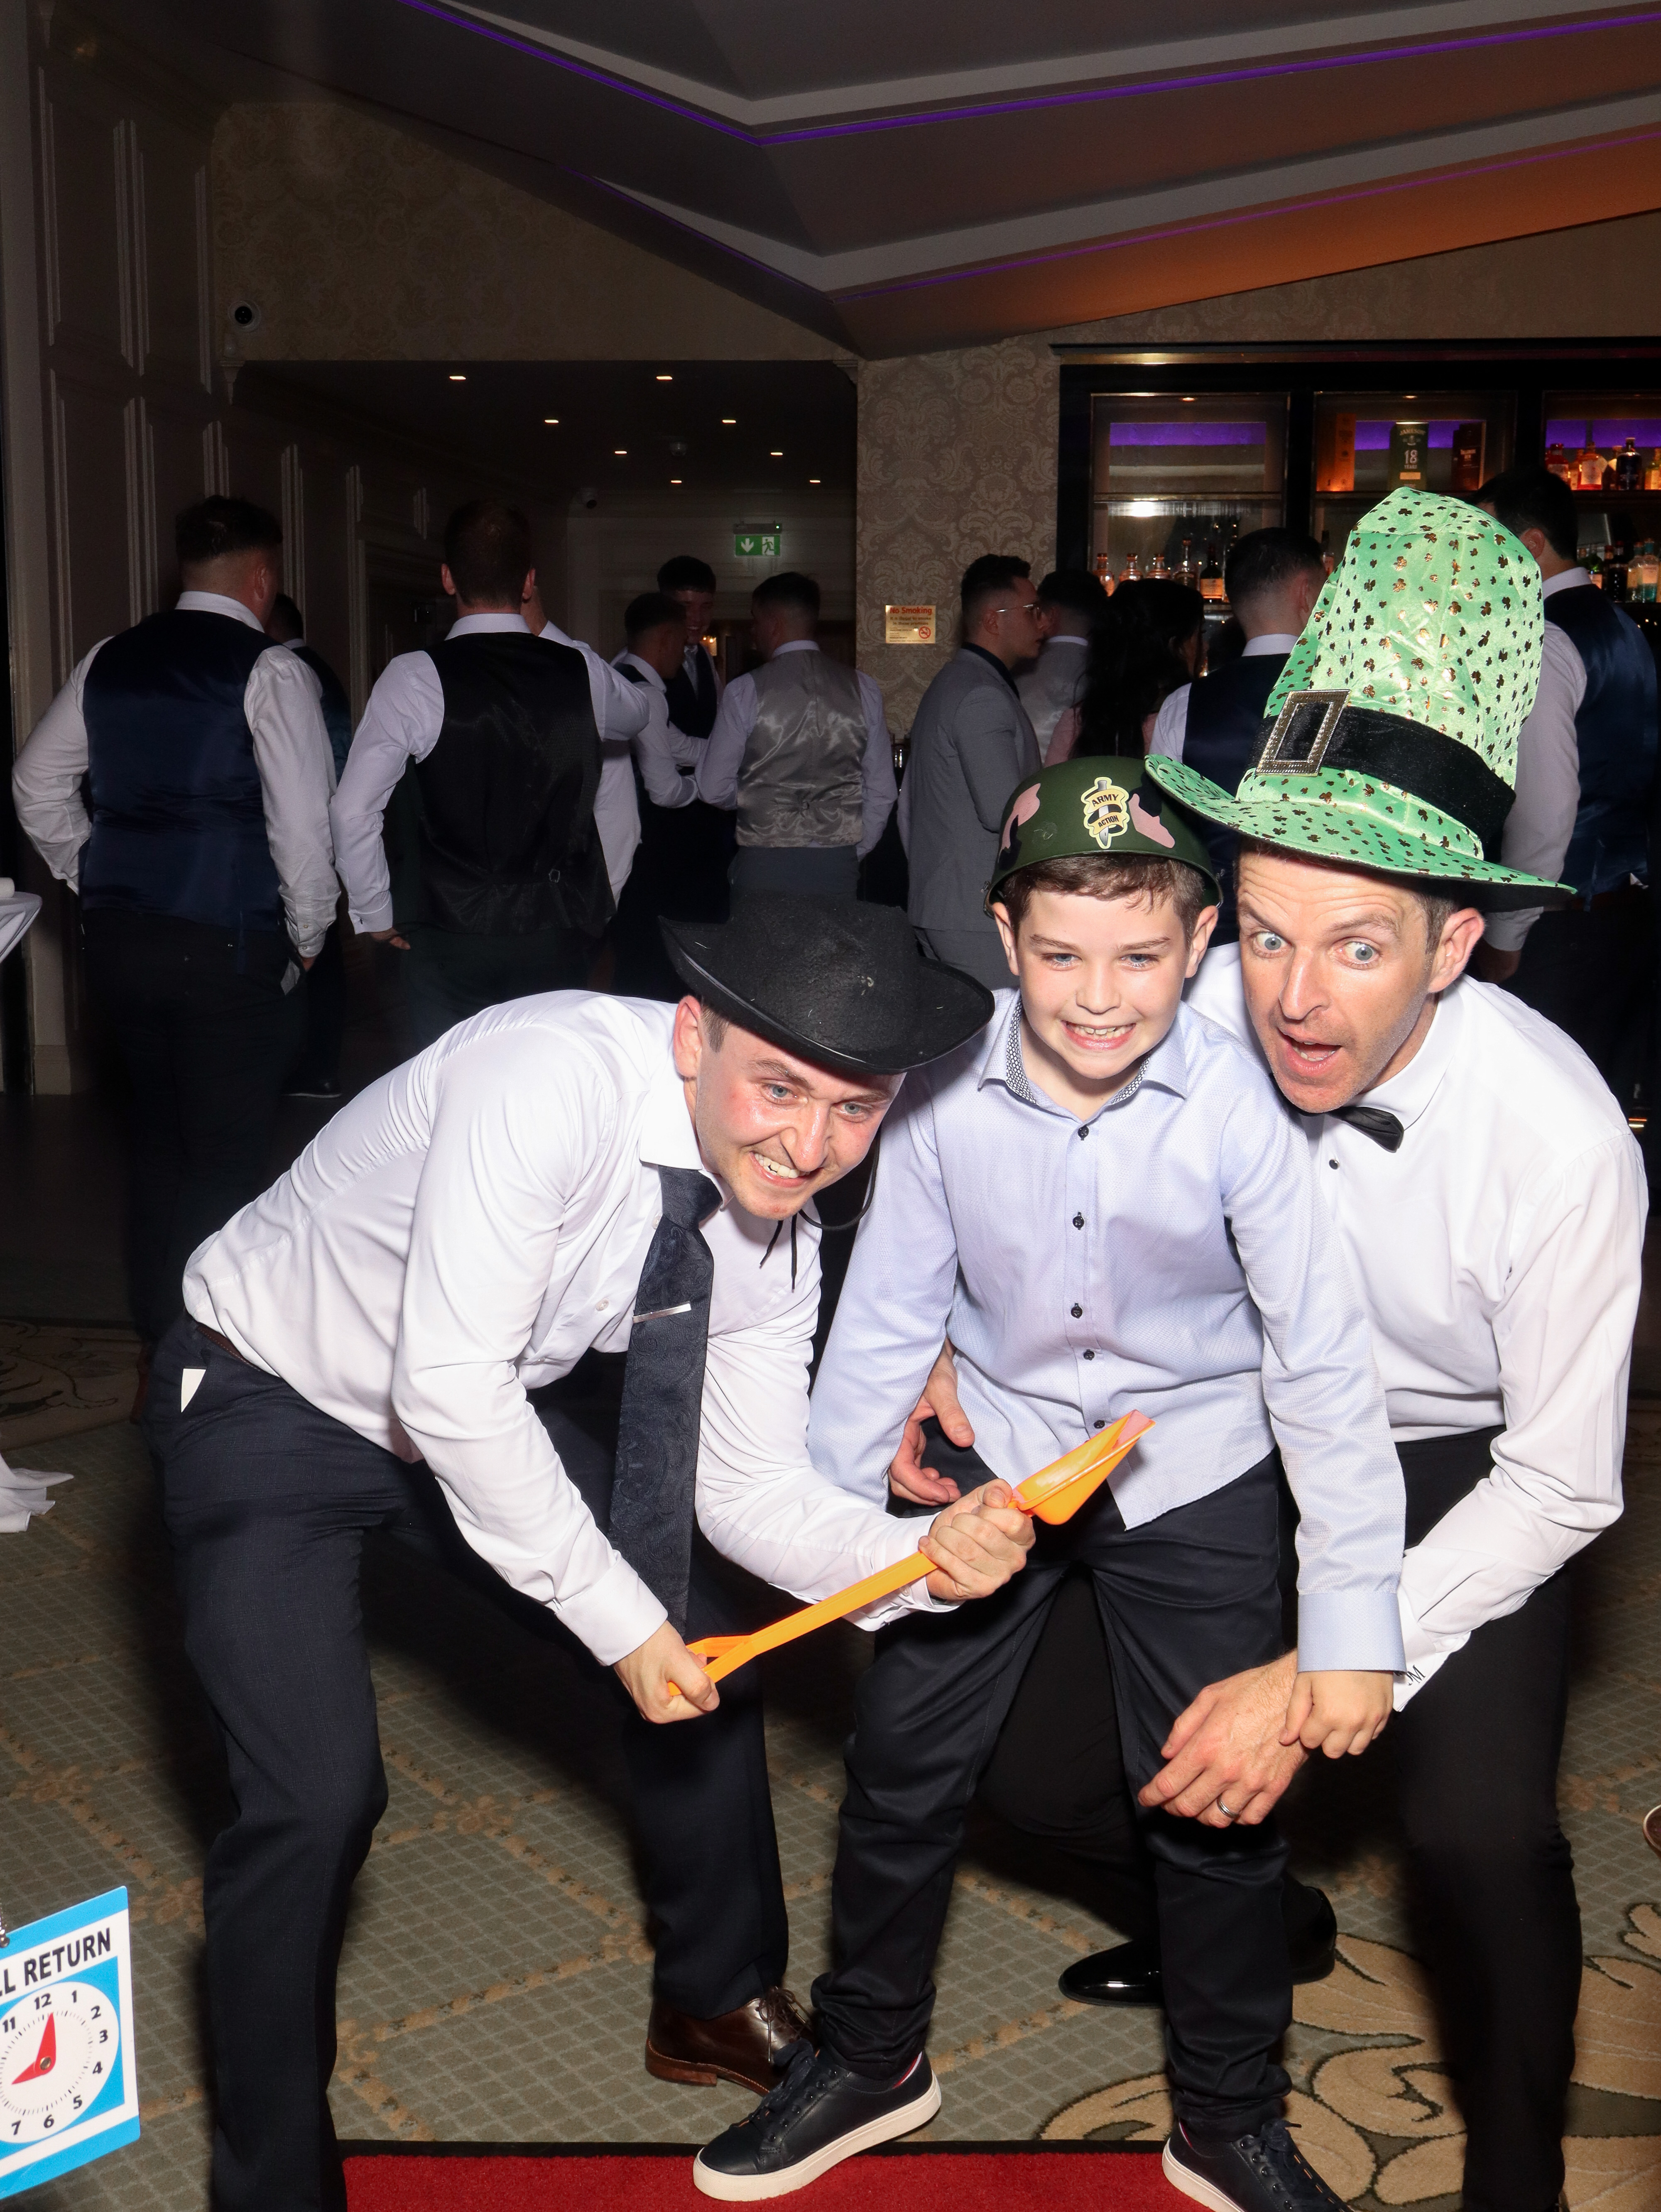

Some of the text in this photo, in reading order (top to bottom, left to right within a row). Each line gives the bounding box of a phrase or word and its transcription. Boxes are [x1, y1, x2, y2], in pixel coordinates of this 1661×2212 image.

[1404, 450, 1418, 464] 18
[902, 607, 932, 615] Smoking
[1092, 794, 1119, 807] ARMY
[1098, 815, 1119, 827] ACTION
[0, 1927, 111, 1997] L RETURN
[34, 1993, 51, 2010] 12
[71, 1990, 77, 2003] 1
[91, 2005, 101, 2020] 2
[2, 2016, 16, 2033] 11
[99, 2029, 108, 2043] 3
[92, 2060, 103, 2075] 4
[73, 2095, 83, 2109] 5
[11, 2119, 21, 2136] 7
[43, 2114, 54, 2128] 6
